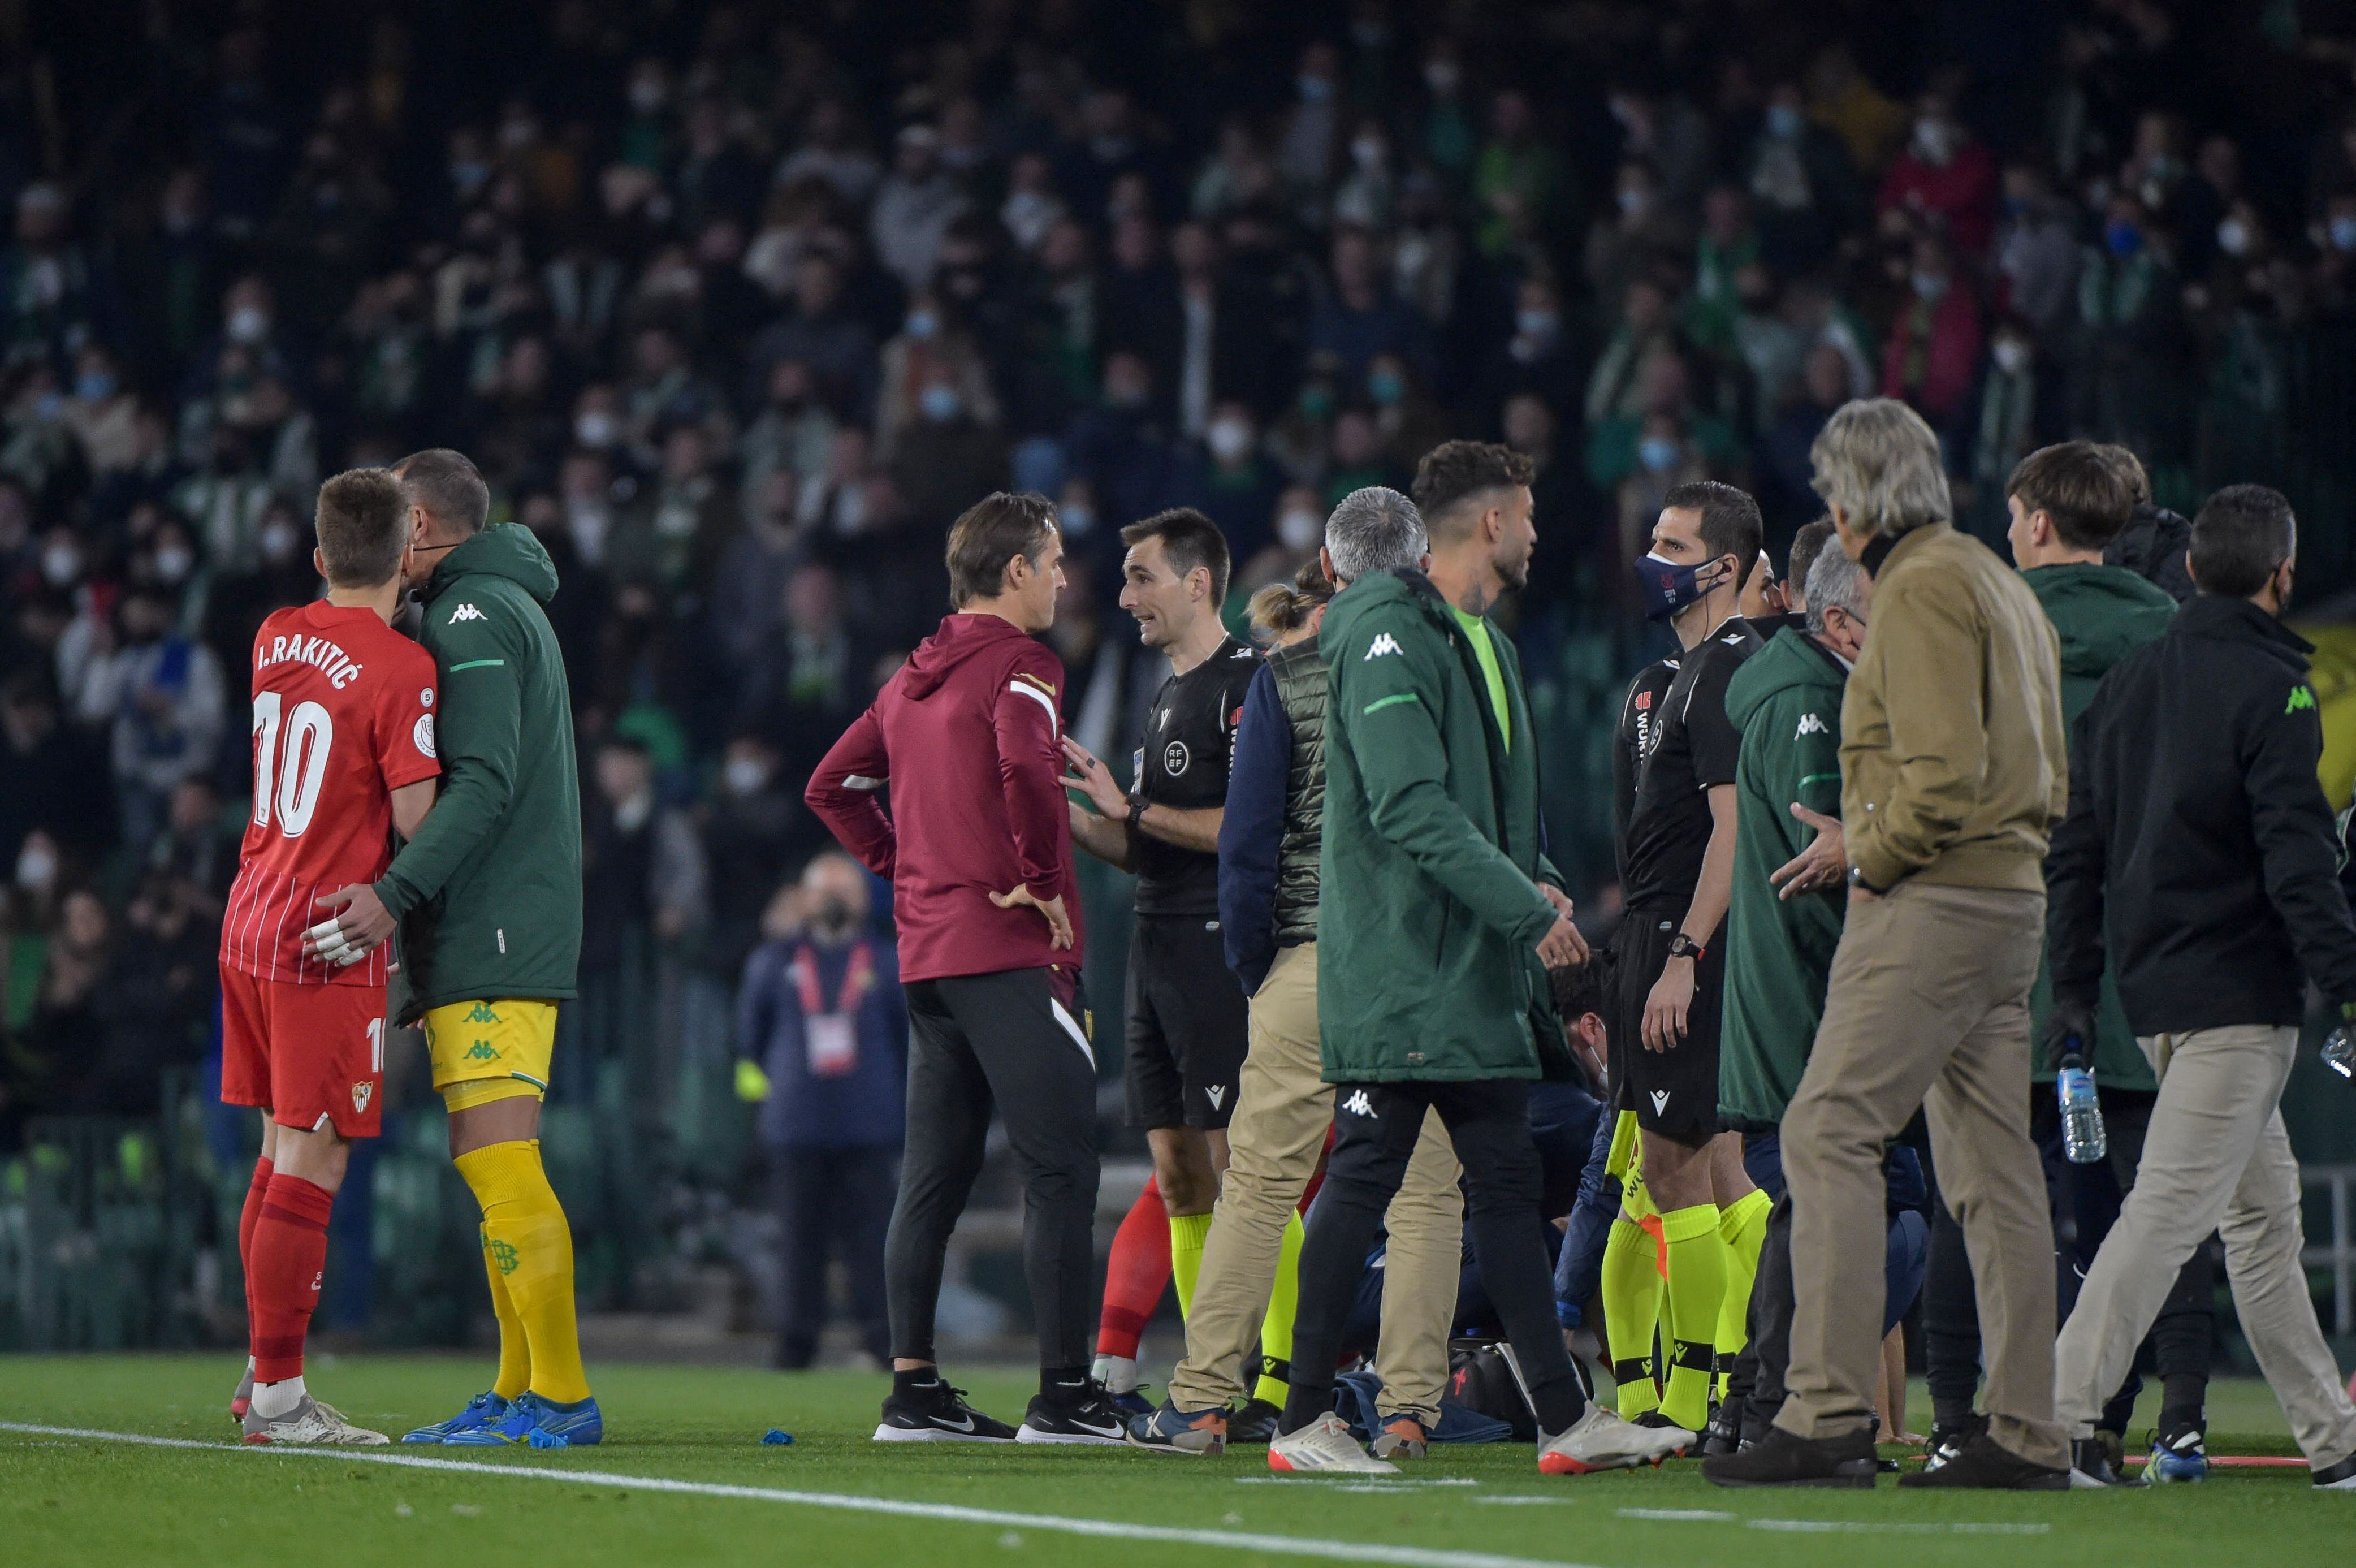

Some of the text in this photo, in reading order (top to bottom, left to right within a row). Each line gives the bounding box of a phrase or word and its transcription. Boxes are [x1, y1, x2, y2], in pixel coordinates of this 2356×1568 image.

[258, 634, 364, 689] I.RAKITIĆ
[253, 690, 333, 839] 10
[366, 1017, 386, 1073] 1
